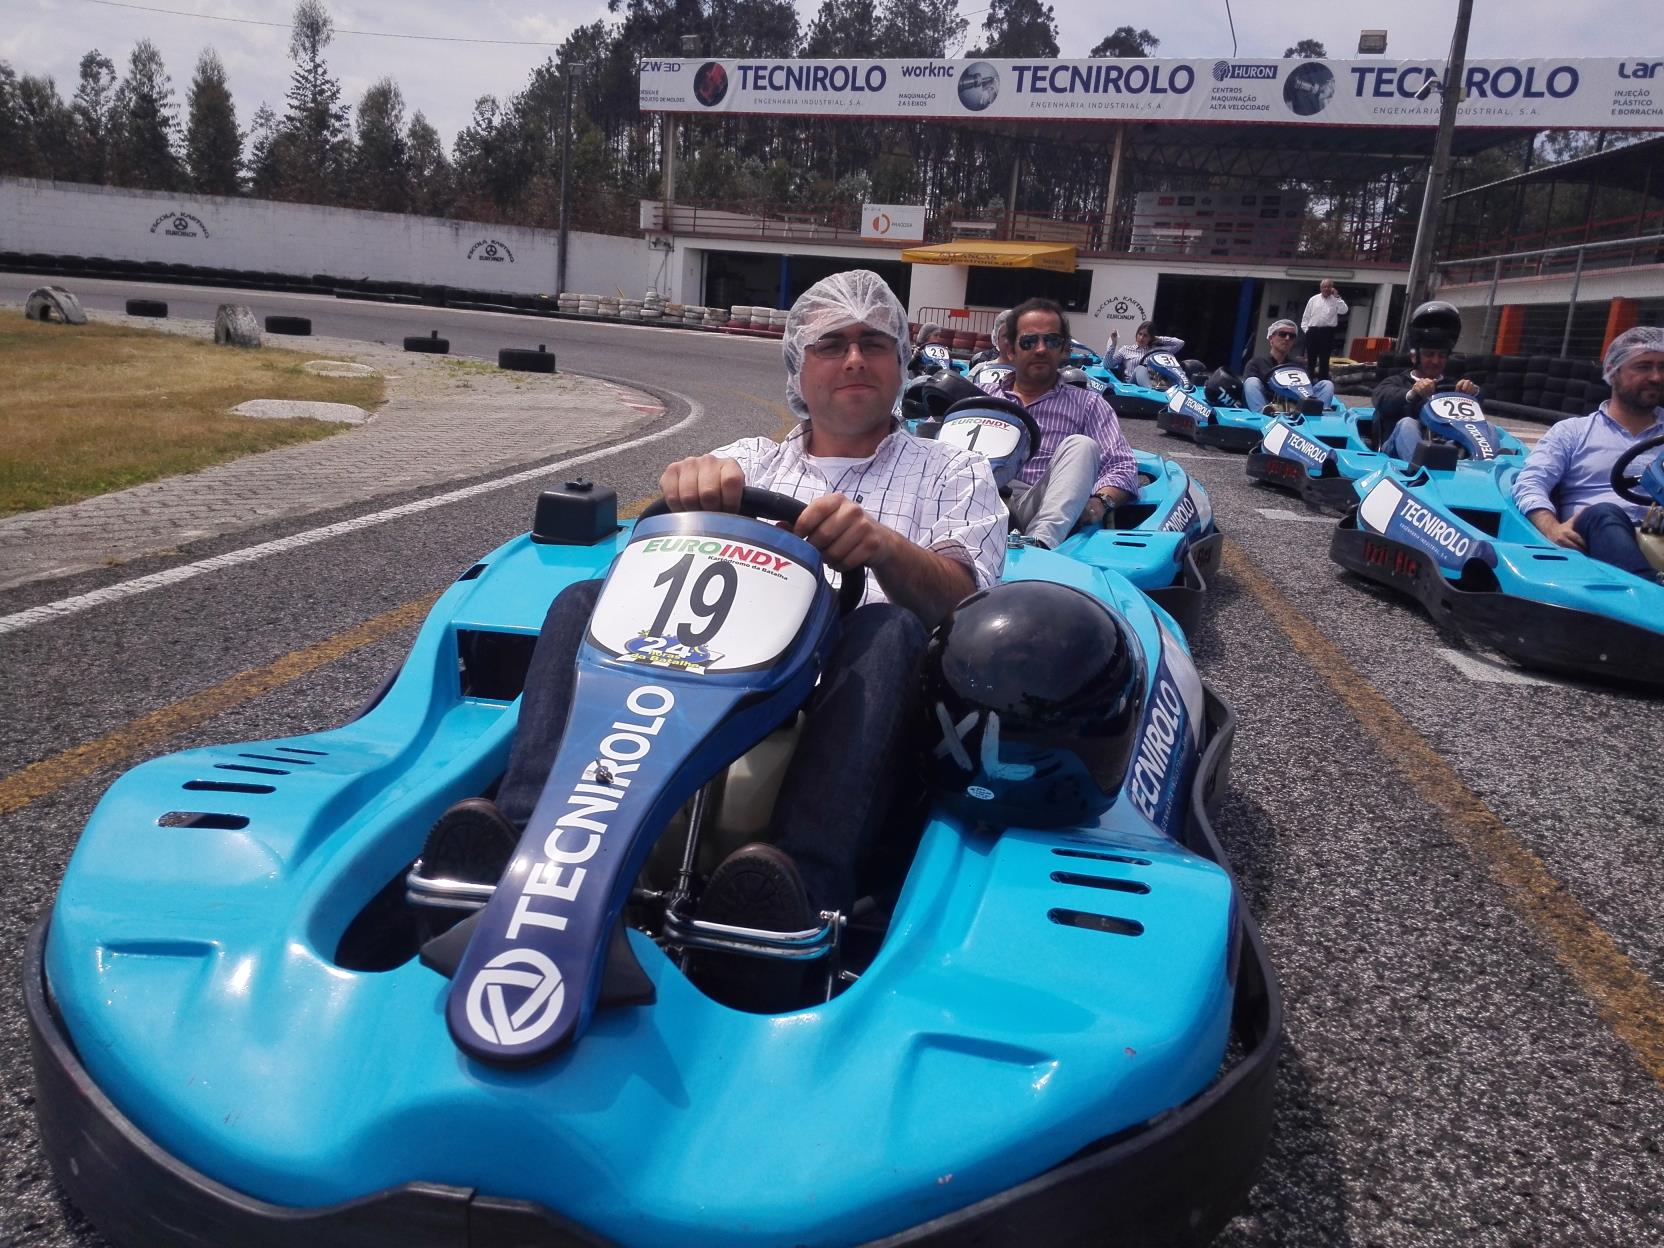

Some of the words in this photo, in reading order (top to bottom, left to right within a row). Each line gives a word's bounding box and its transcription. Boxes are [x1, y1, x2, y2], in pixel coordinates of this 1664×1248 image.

[737, 65, 887, 93] TECNIROLO
[901, 61, 954, 78] worknc
[1234, 66, 1275, 78] HURON
[1011, 64, 1196, 95] TECNIROLO
[1350, 65, 1580, 99] TECNROLO
[754, 97, 799, 105] ENGENHARIA
[1612, 98, 1653, 106] PLÁSTICO
[1614, 88, 1650, 98] INJEÇÃO
[1030, 101, 1085, 109] ENGENHARIA
[1373, 106, 1440, 116] ENGENHARIA
[1617, 108, 1664, 116] BORRACHA
[930, 348, 946, 358] 29
[1287, 373, 1301, 383] 5
[1185, 397, 1212, 418] TECNIROLO
[1443, 400, 1475, 417] 26
[951, 418, 1010, 429] EUROINDY
[966, 423, 982, 451] 1
[1287, 433, 1328, 464] TECNIROLO
[1400, 499, 1469, 557] TECNIROLO
[643, 538, 793, 572] EUROINDY
[761, 567, 789, 581] Batalha
[649, 553, 738, 648] 19
[638, 636, 693, 659] 24
[933, 701, 1036, 781] XL
[1132, 680, 1181, 822] ECNIROLO
[505, 685, 675, 940] TECNIROLO
